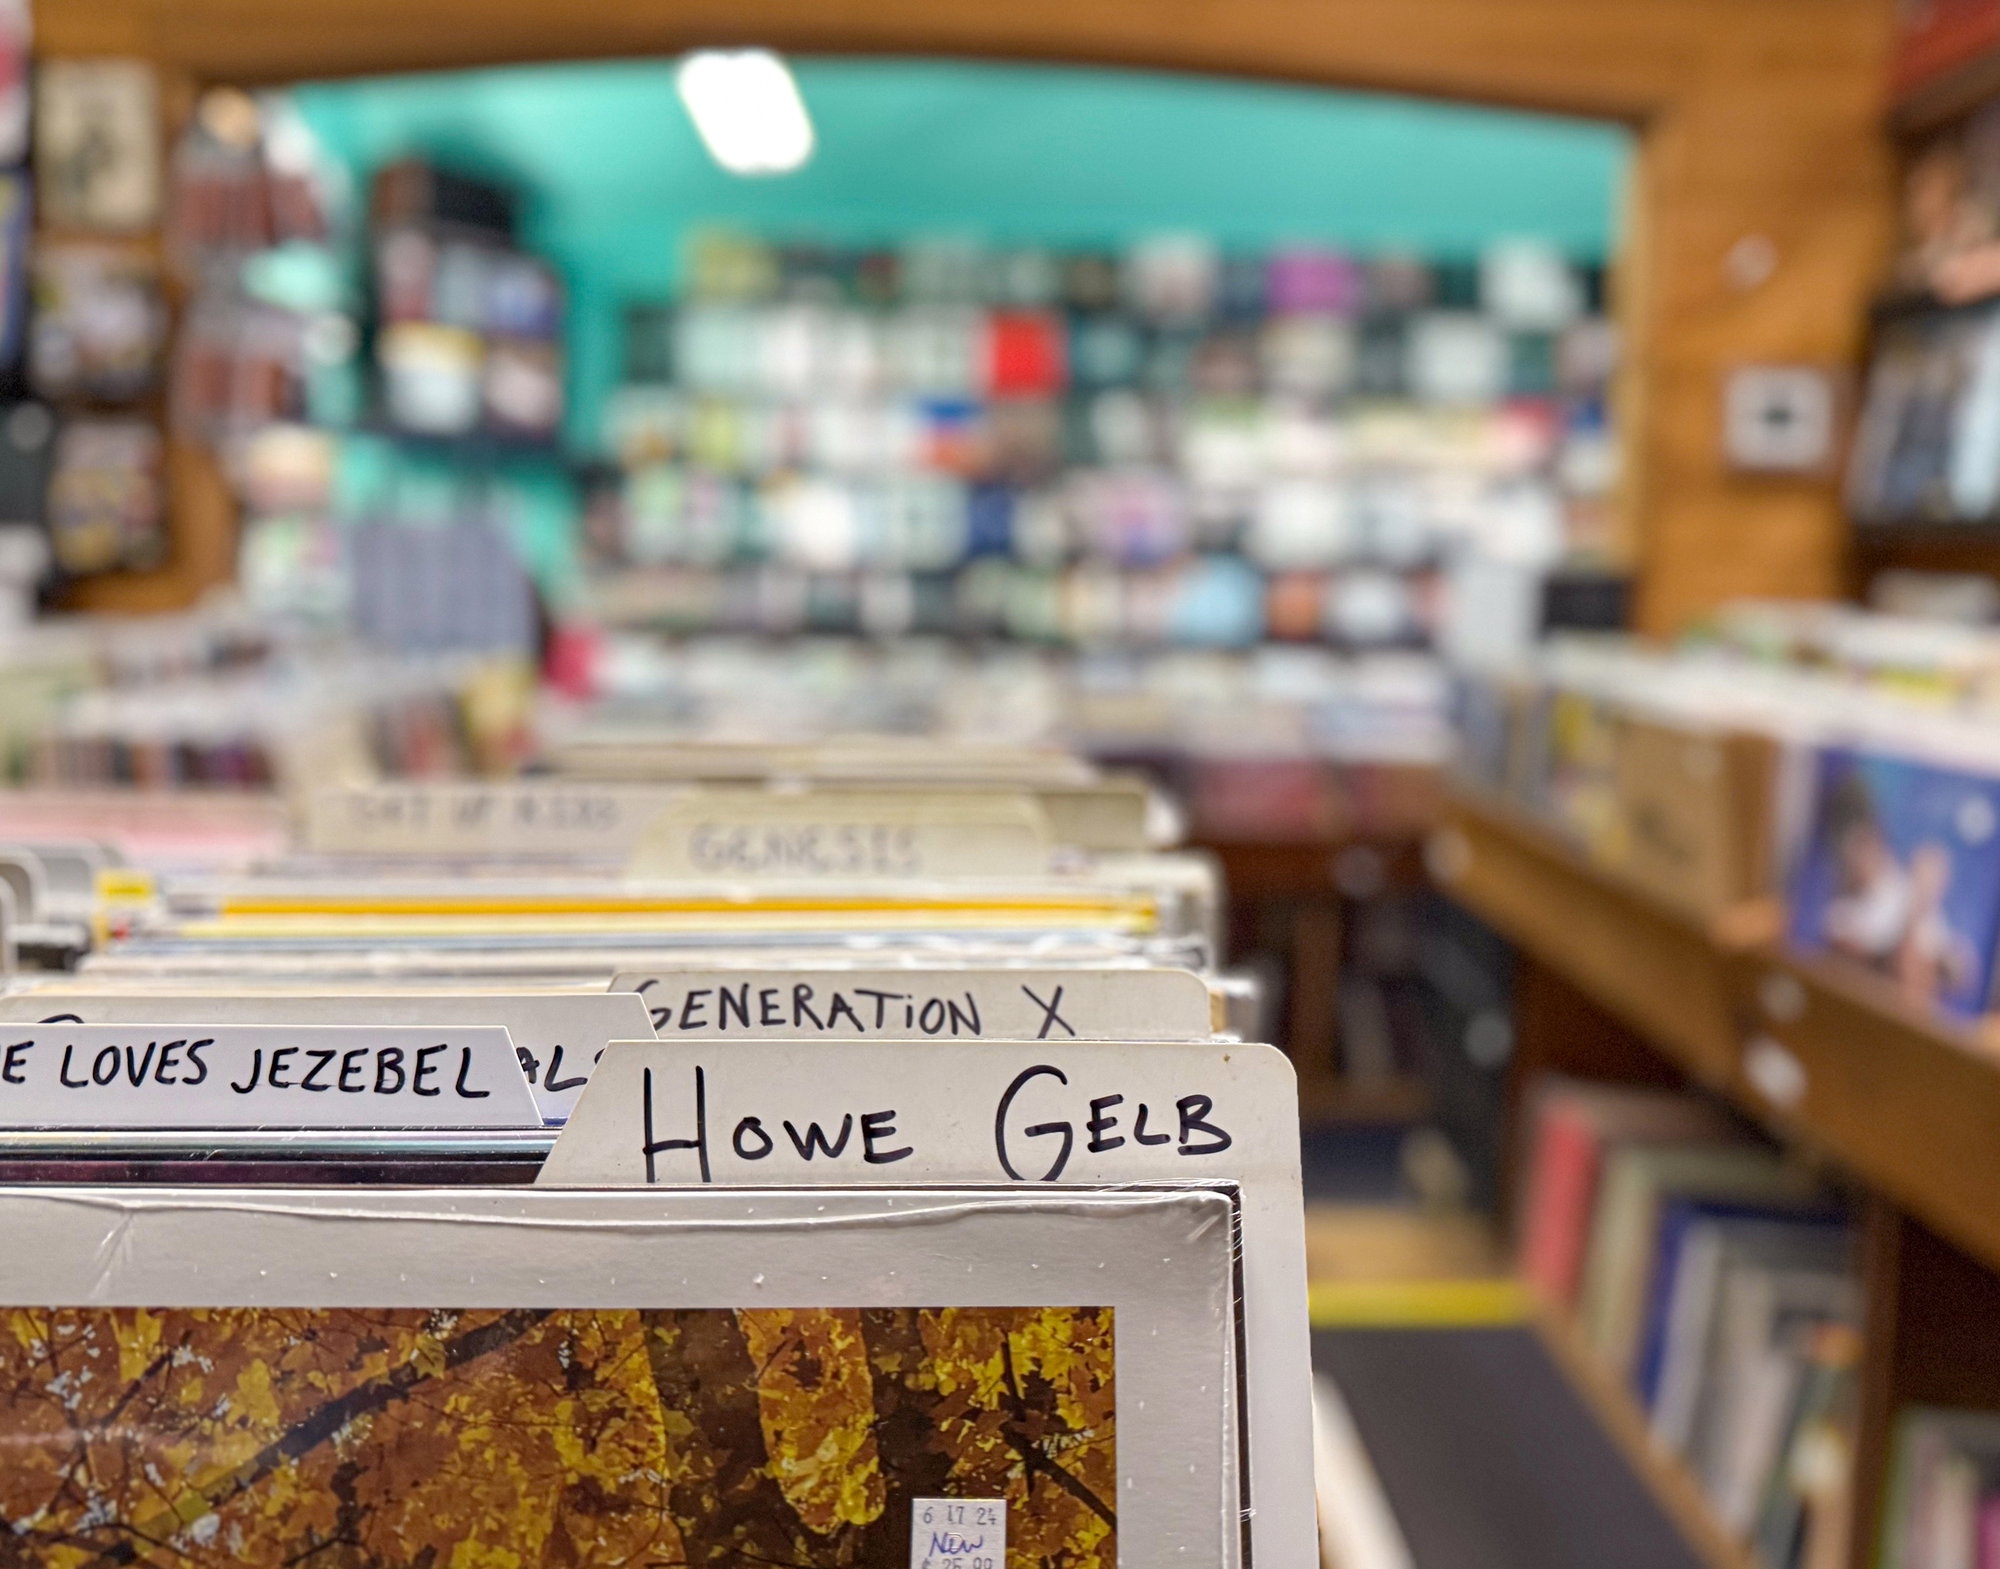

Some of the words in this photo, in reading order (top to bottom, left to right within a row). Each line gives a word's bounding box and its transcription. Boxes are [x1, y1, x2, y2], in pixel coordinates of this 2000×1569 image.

[688, 822, 924, 879] GENESIS
[1021, 984, 1076, 1039] X
[60, 1038, 215, 1088] LOVES
[231, 1044, 490, 1098] JEZEBEL
[643, 1065, 914, 1183] HOWE
[995, 1064, 1232, 1182] GELB
[923, 1506, 934, 1524] 6
[947, 1505, 965, 1525] 17
[976, 1507, 997, 1525] 24
